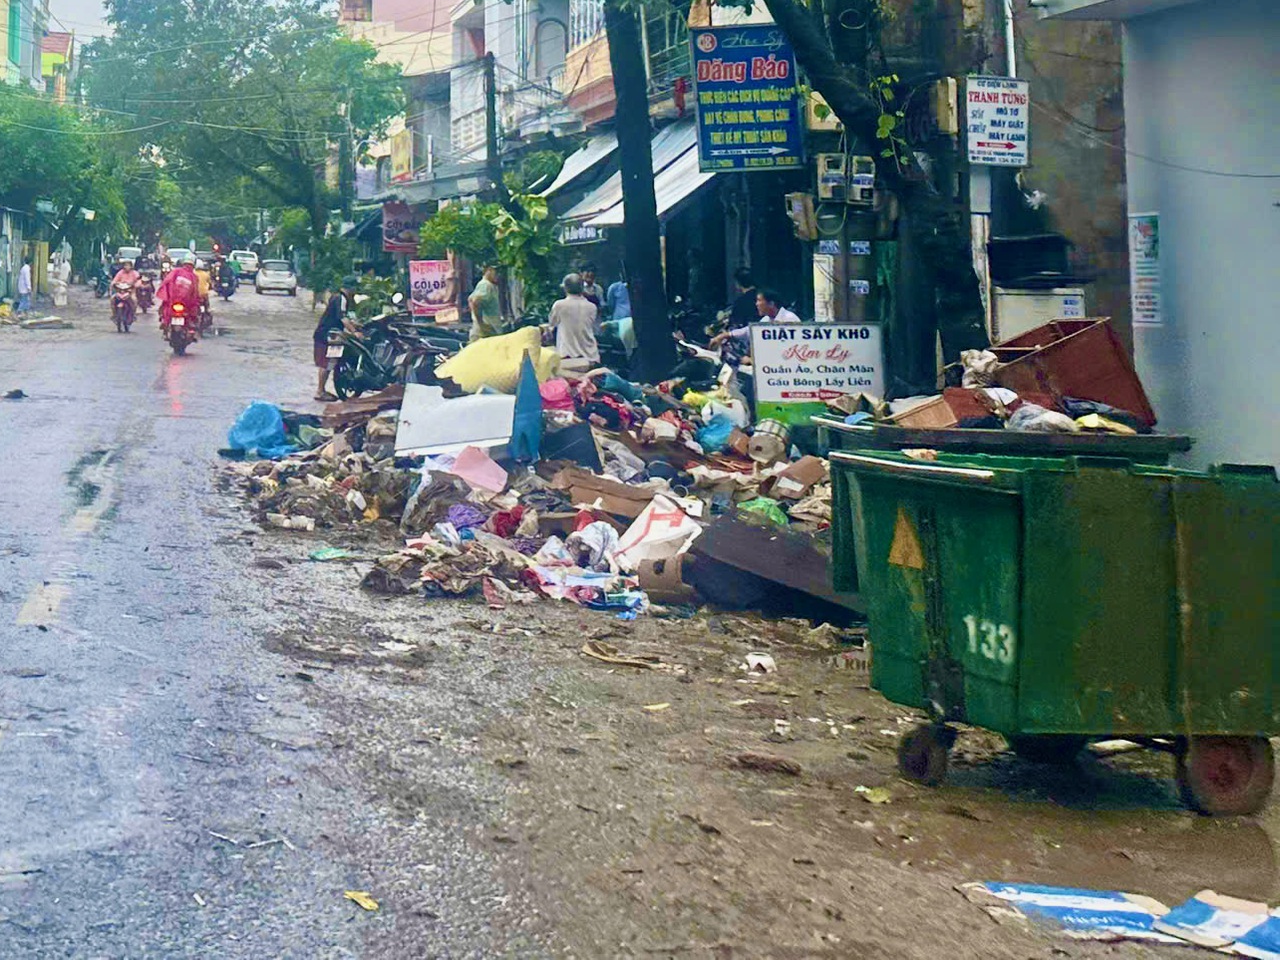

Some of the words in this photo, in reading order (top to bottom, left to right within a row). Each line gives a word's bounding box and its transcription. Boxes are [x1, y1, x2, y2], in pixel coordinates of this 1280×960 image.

[697, 58, 747, 84] Đăng
[751, 53, 789, 81] Bảo
[761, 328, 796, 342] GIẶT
[837, 326, 870, 340] KHÔ
[782, 343, 821, 362] Kim
[963, 614, 1016, 665] 133
